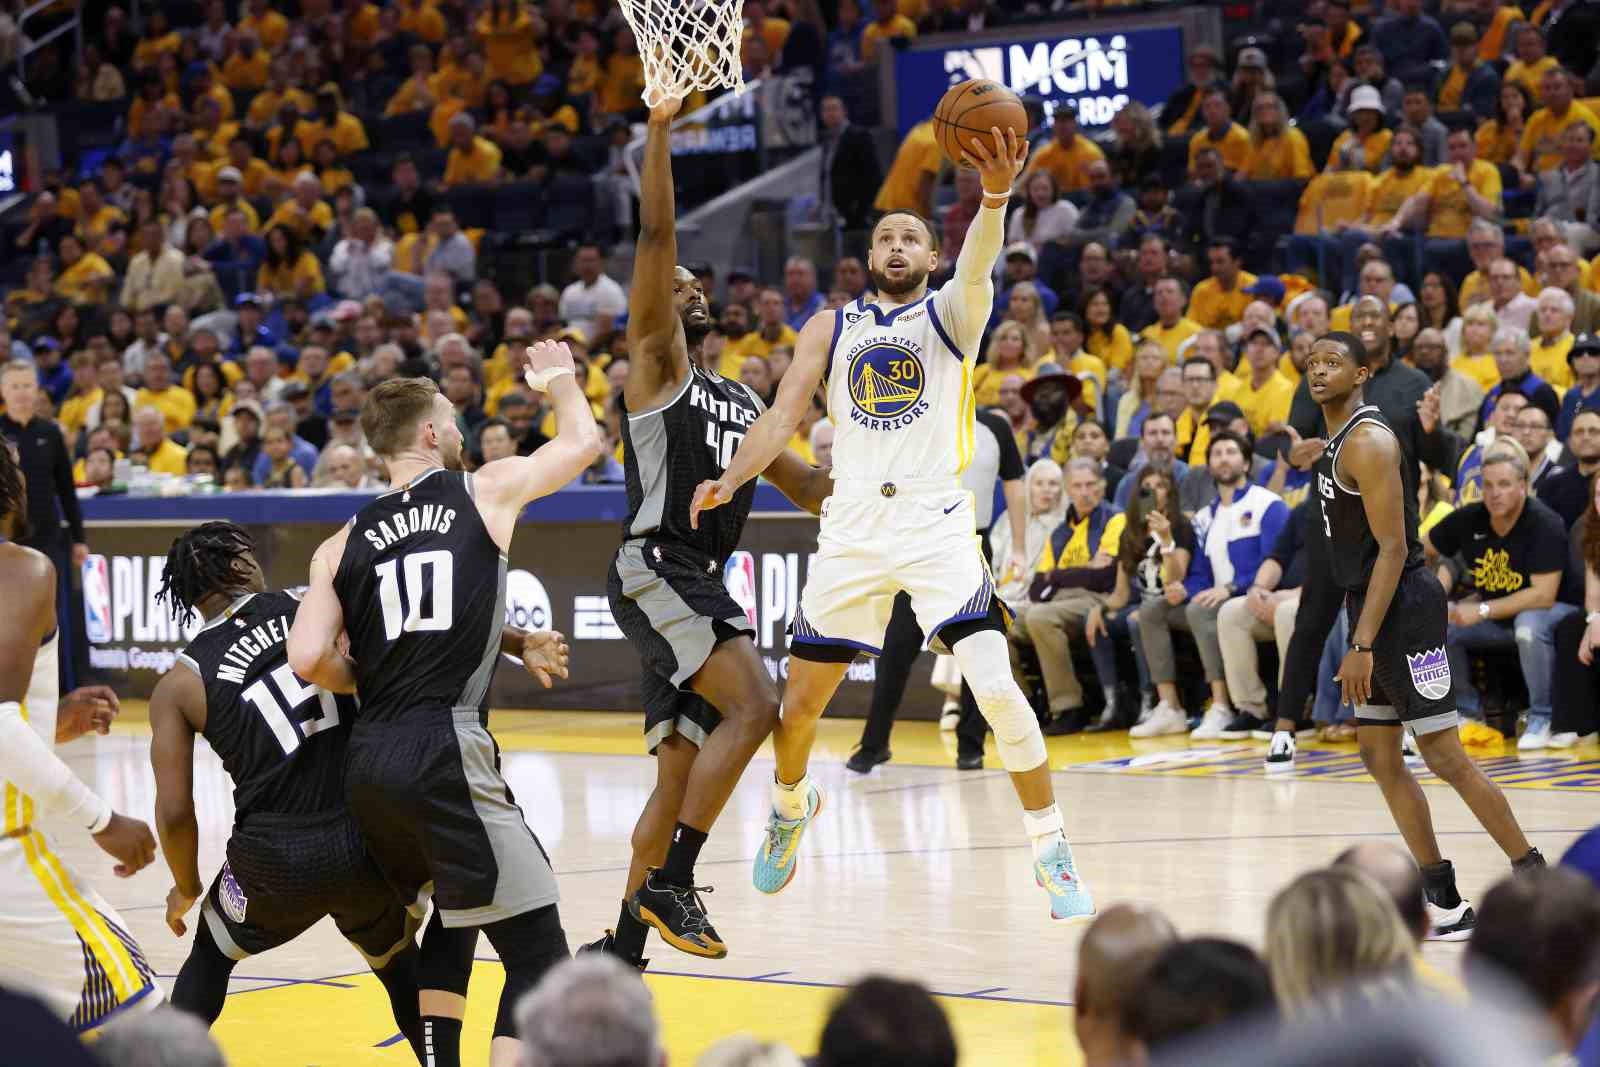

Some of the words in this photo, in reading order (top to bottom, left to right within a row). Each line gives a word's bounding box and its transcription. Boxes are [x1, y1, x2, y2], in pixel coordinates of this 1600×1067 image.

[1008, 36, 1129, 95] MGM
[846, 336, 887, 361] GOLDEN
[891, 336, 922, 354] STATE
[888, 360, 915, 380] 30
[689, 384, 757, 428] KINGS
[850, 399, 929, 431] WARRIORS
[364, 504, 456, 551] SABONIS
[375, 550, 453, 641] 10
[216, 616, 289, 684] MITCHEL
[1413, 666, 1450, 684] KINGS
[240, 663, 340, 756] 15
